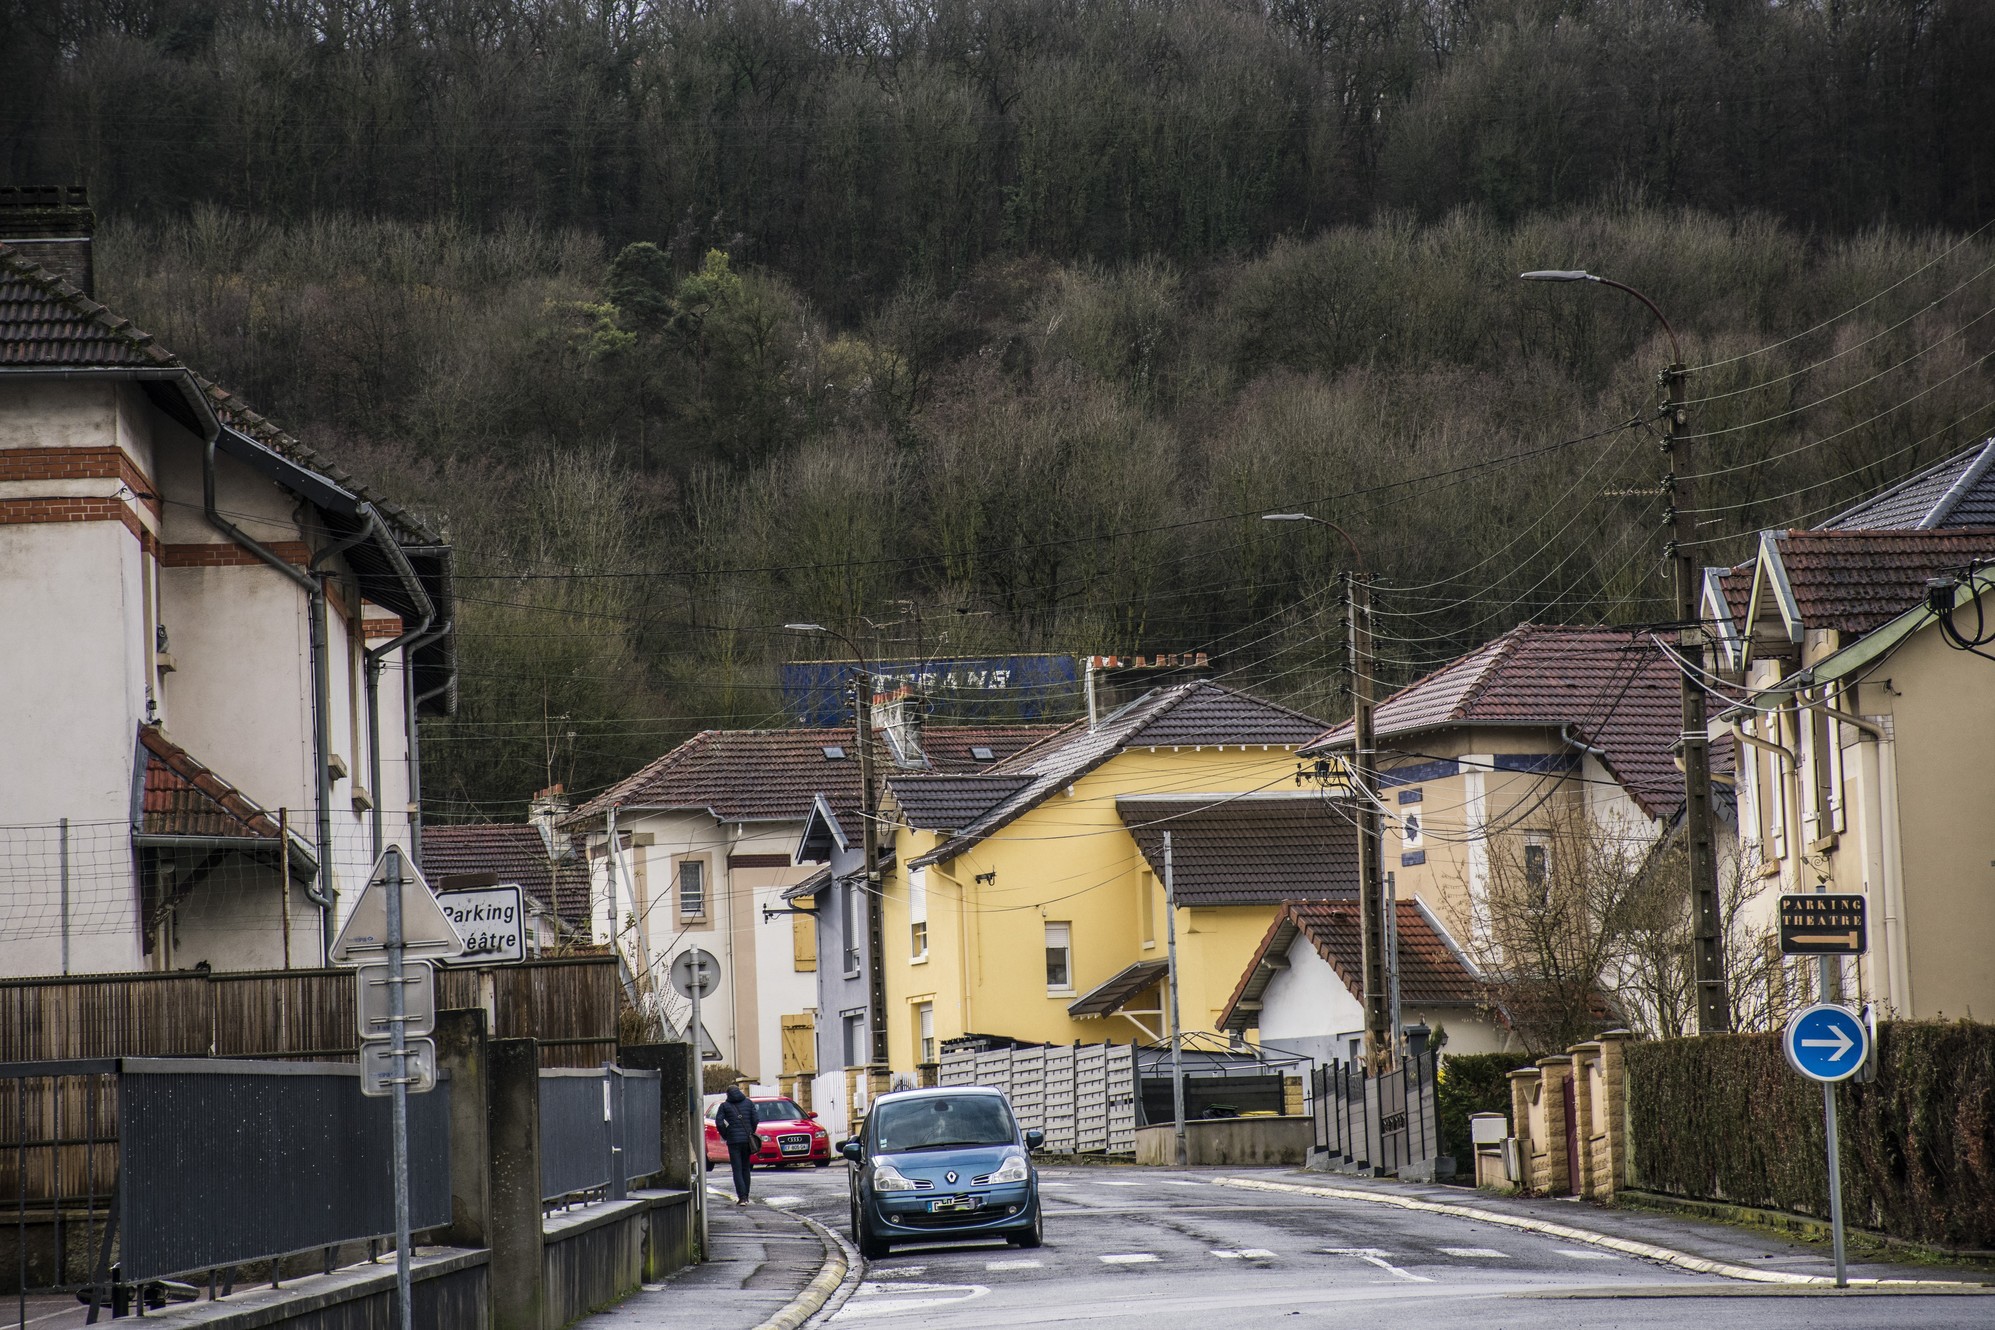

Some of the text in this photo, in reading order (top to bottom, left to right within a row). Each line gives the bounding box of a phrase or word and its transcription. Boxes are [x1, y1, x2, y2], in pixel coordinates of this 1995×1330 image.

[1782, 900, 1861, 910] PARKING
[443, 904, 514, 924] Parking
[1782, 915, 1862, 926] THEATRE
[462, 932, 516, 951] éâtre
